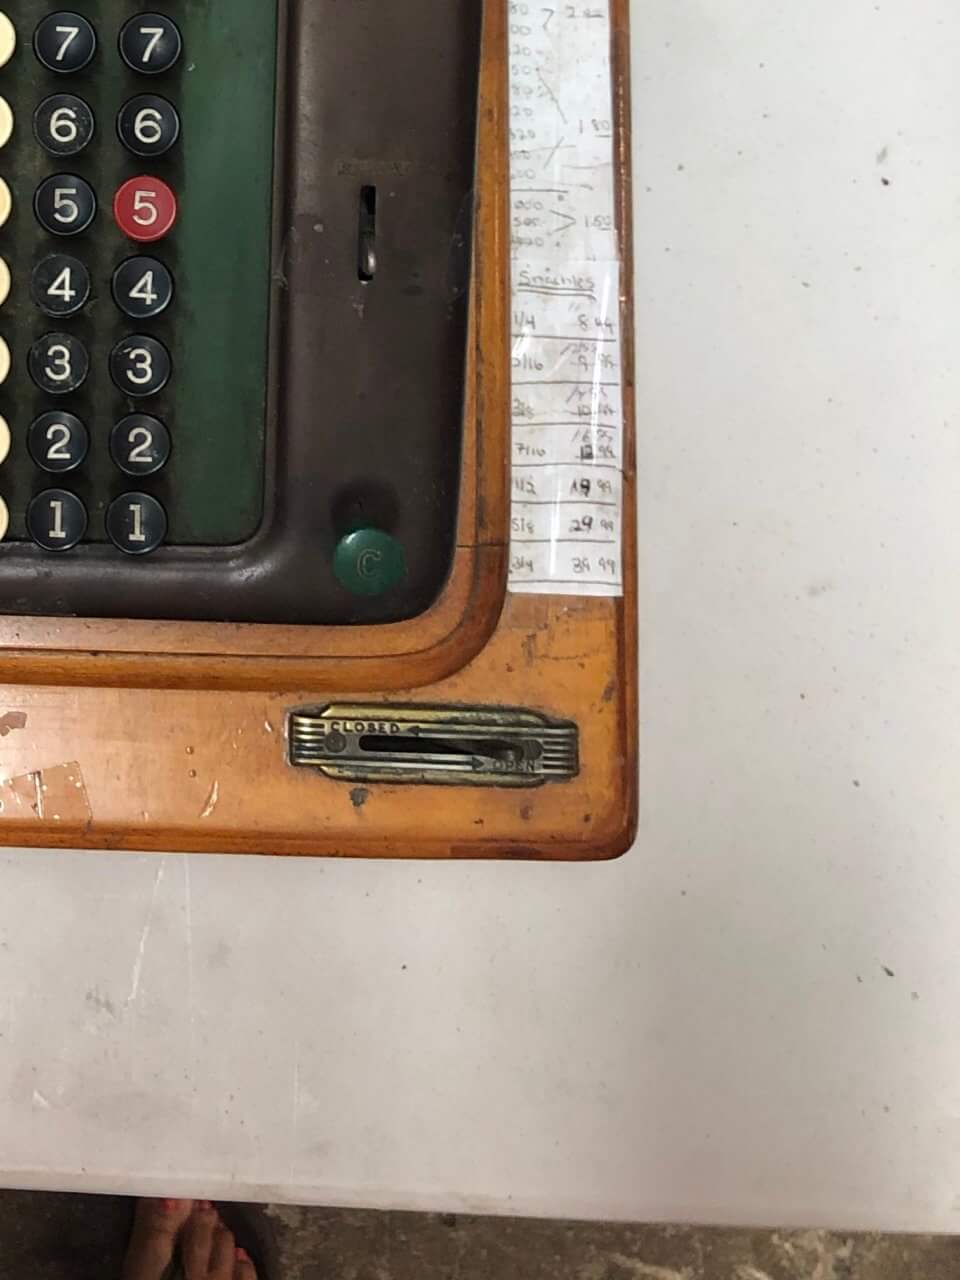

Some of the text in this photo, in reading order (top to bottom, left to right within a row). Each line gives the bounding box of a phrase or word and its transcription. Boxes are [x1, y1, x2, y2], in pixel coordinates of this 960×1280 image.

[56, 26, 78, 60] 7
[141, 28, 163, 61] 7
[50, 108, 76, 142] 6
[135, 109, 162, 143] 6
[54, 189, 78, 222] 5
[133, 191, 157, 225] 5
[48, 268, 75, 301] 4
[130, 271, 157, 304] 4
[46, 345, 70, 380] 3
[127, 349, 152, 383] 3
[47, 424, 70, 458] 2
[129, 428, 152, 462] 2
[49, 501, 66, 538] 1
[128, 505, 146, 541] 1
[357, 548, 382, 580] C
[330, 721, 400, 735] CLOSED
[492, 759, 536, 772] OPEN
